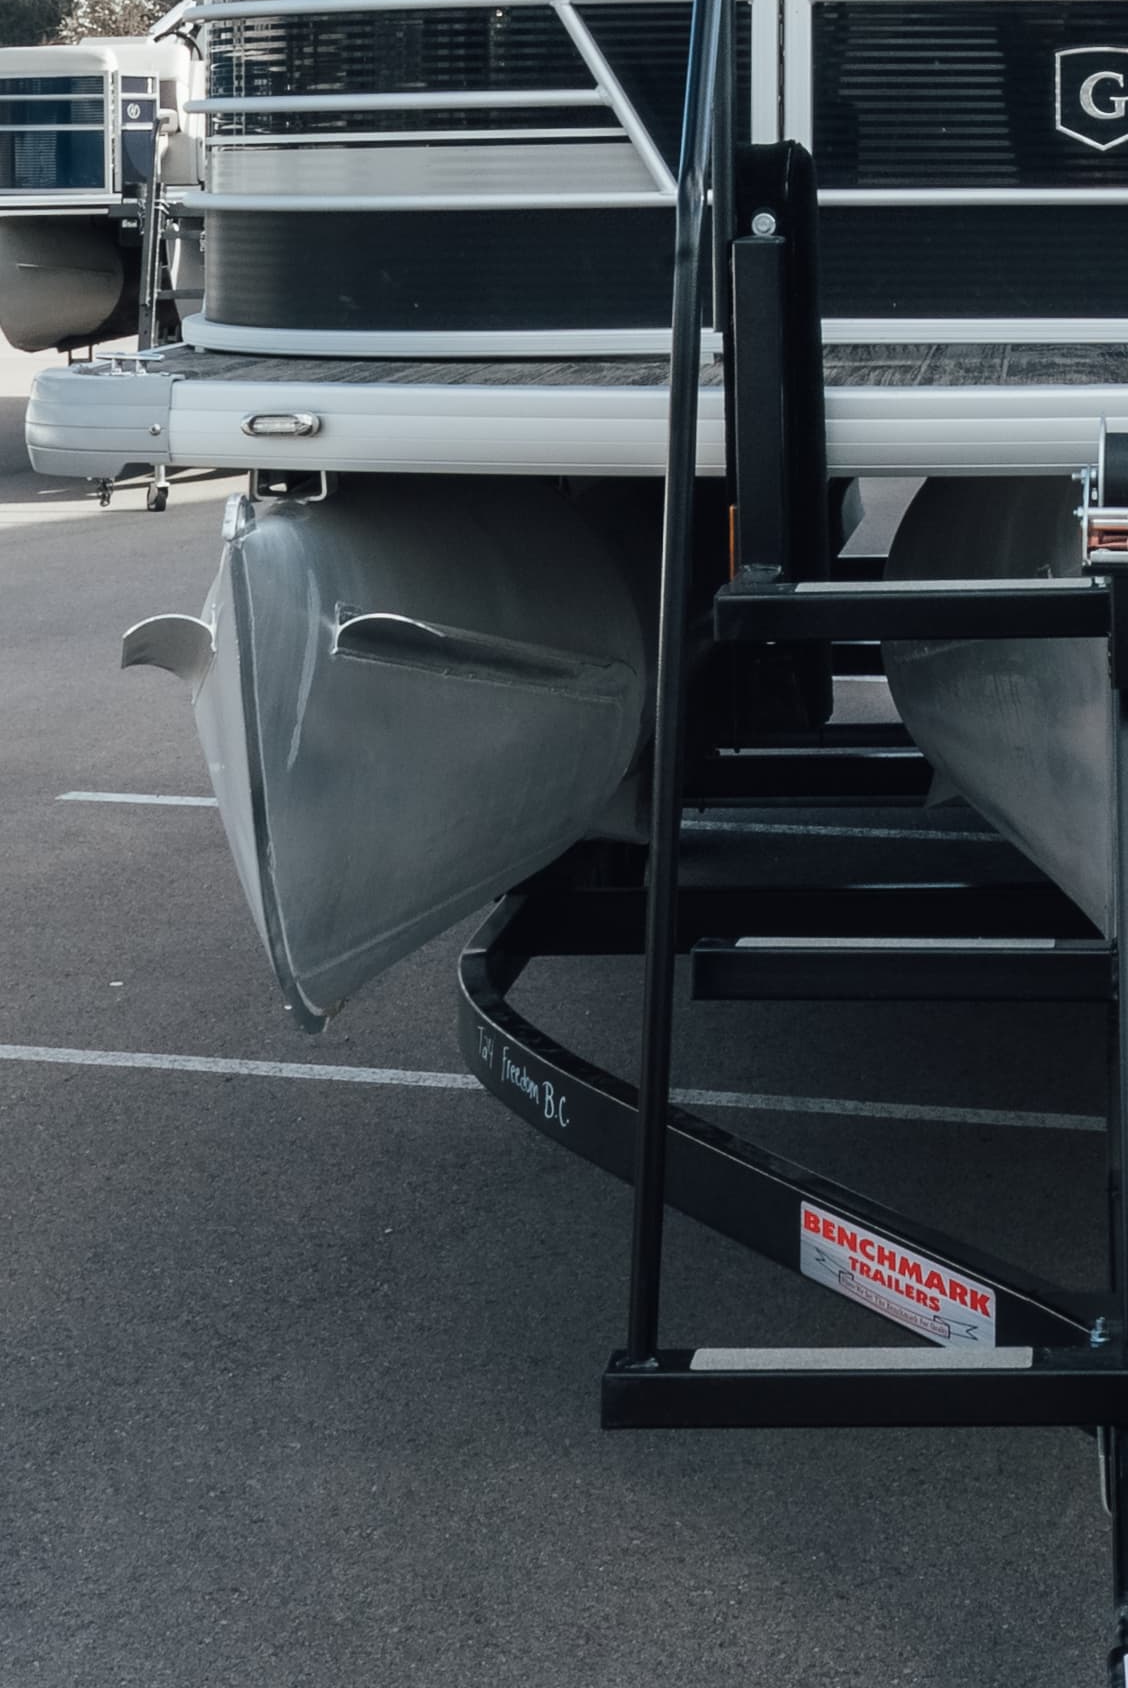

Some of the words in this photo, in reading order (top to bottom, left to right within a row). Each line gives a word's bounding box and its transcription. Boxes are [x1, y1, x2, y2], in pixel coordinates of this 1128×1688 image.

[500, 1046, 540, 1105] Freedom
[542, 1081, 570, 1128] B.C.
[803, 1209, 992, 1318] BENCHMARK
[848, 1255, 941, 1313] TRAILERS
